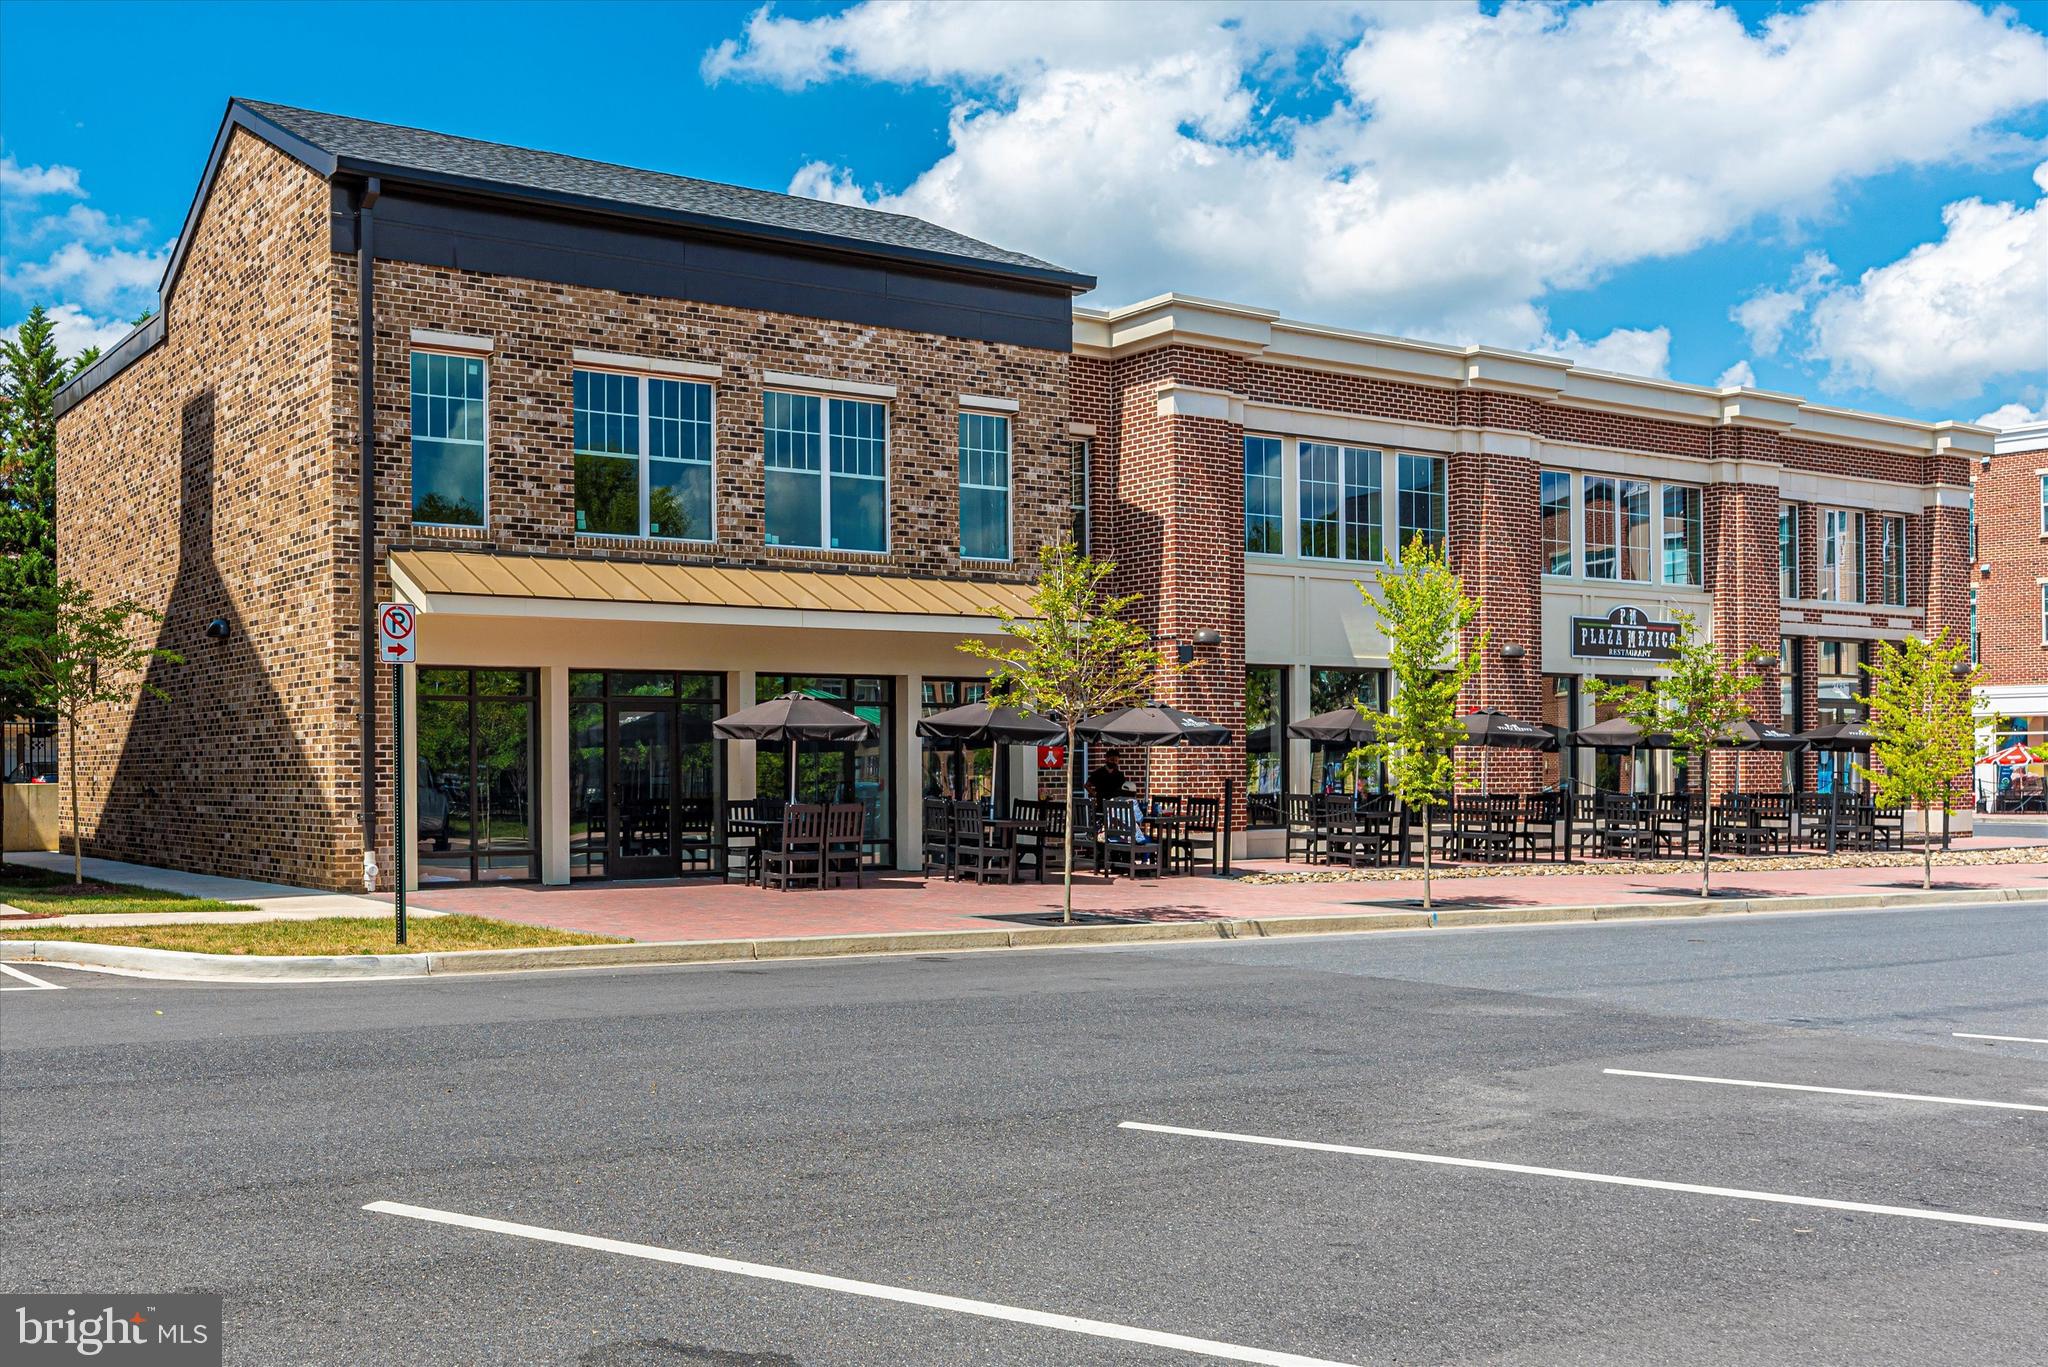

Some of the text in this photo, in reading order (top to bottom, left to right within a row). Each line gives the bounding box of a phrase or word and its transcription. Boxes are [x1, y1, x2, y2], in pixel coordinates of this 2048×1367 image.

[1581, 627, 1676, 648] PLAZA MEXICO
[1608, 648, 1651, 657] RESTAURANT
